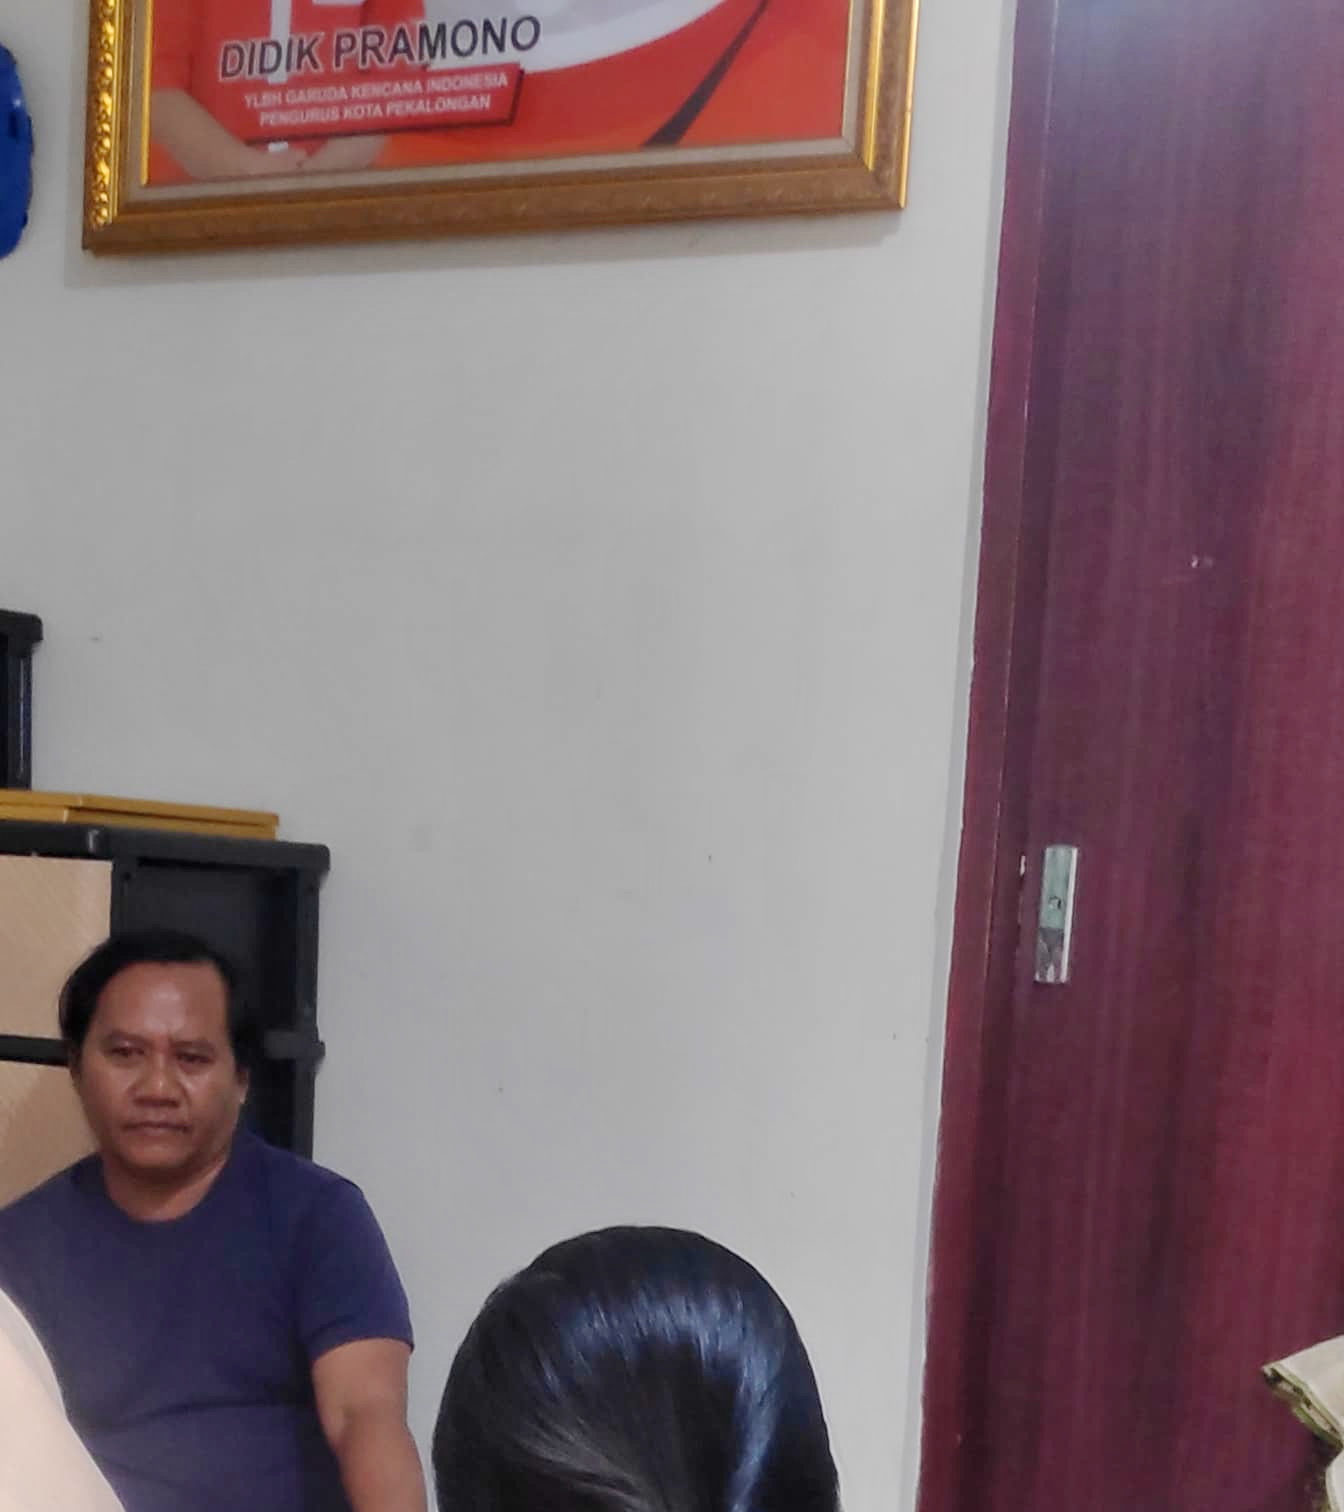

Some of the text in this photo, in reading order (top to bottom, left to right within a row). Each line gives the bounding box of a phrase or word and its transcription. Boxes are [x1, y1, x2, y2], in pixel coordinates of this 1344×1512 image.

[220, 15, 541, 80] DIDIK PRAMONO
[286, 86, 349, 105] GARUDA
[351, 79, 424, 100] KENCANA
[426, 71, 509, 94] INDONESIA
[259, 94, 492, 127] PENGURUS KOTA PEKALONGAN
